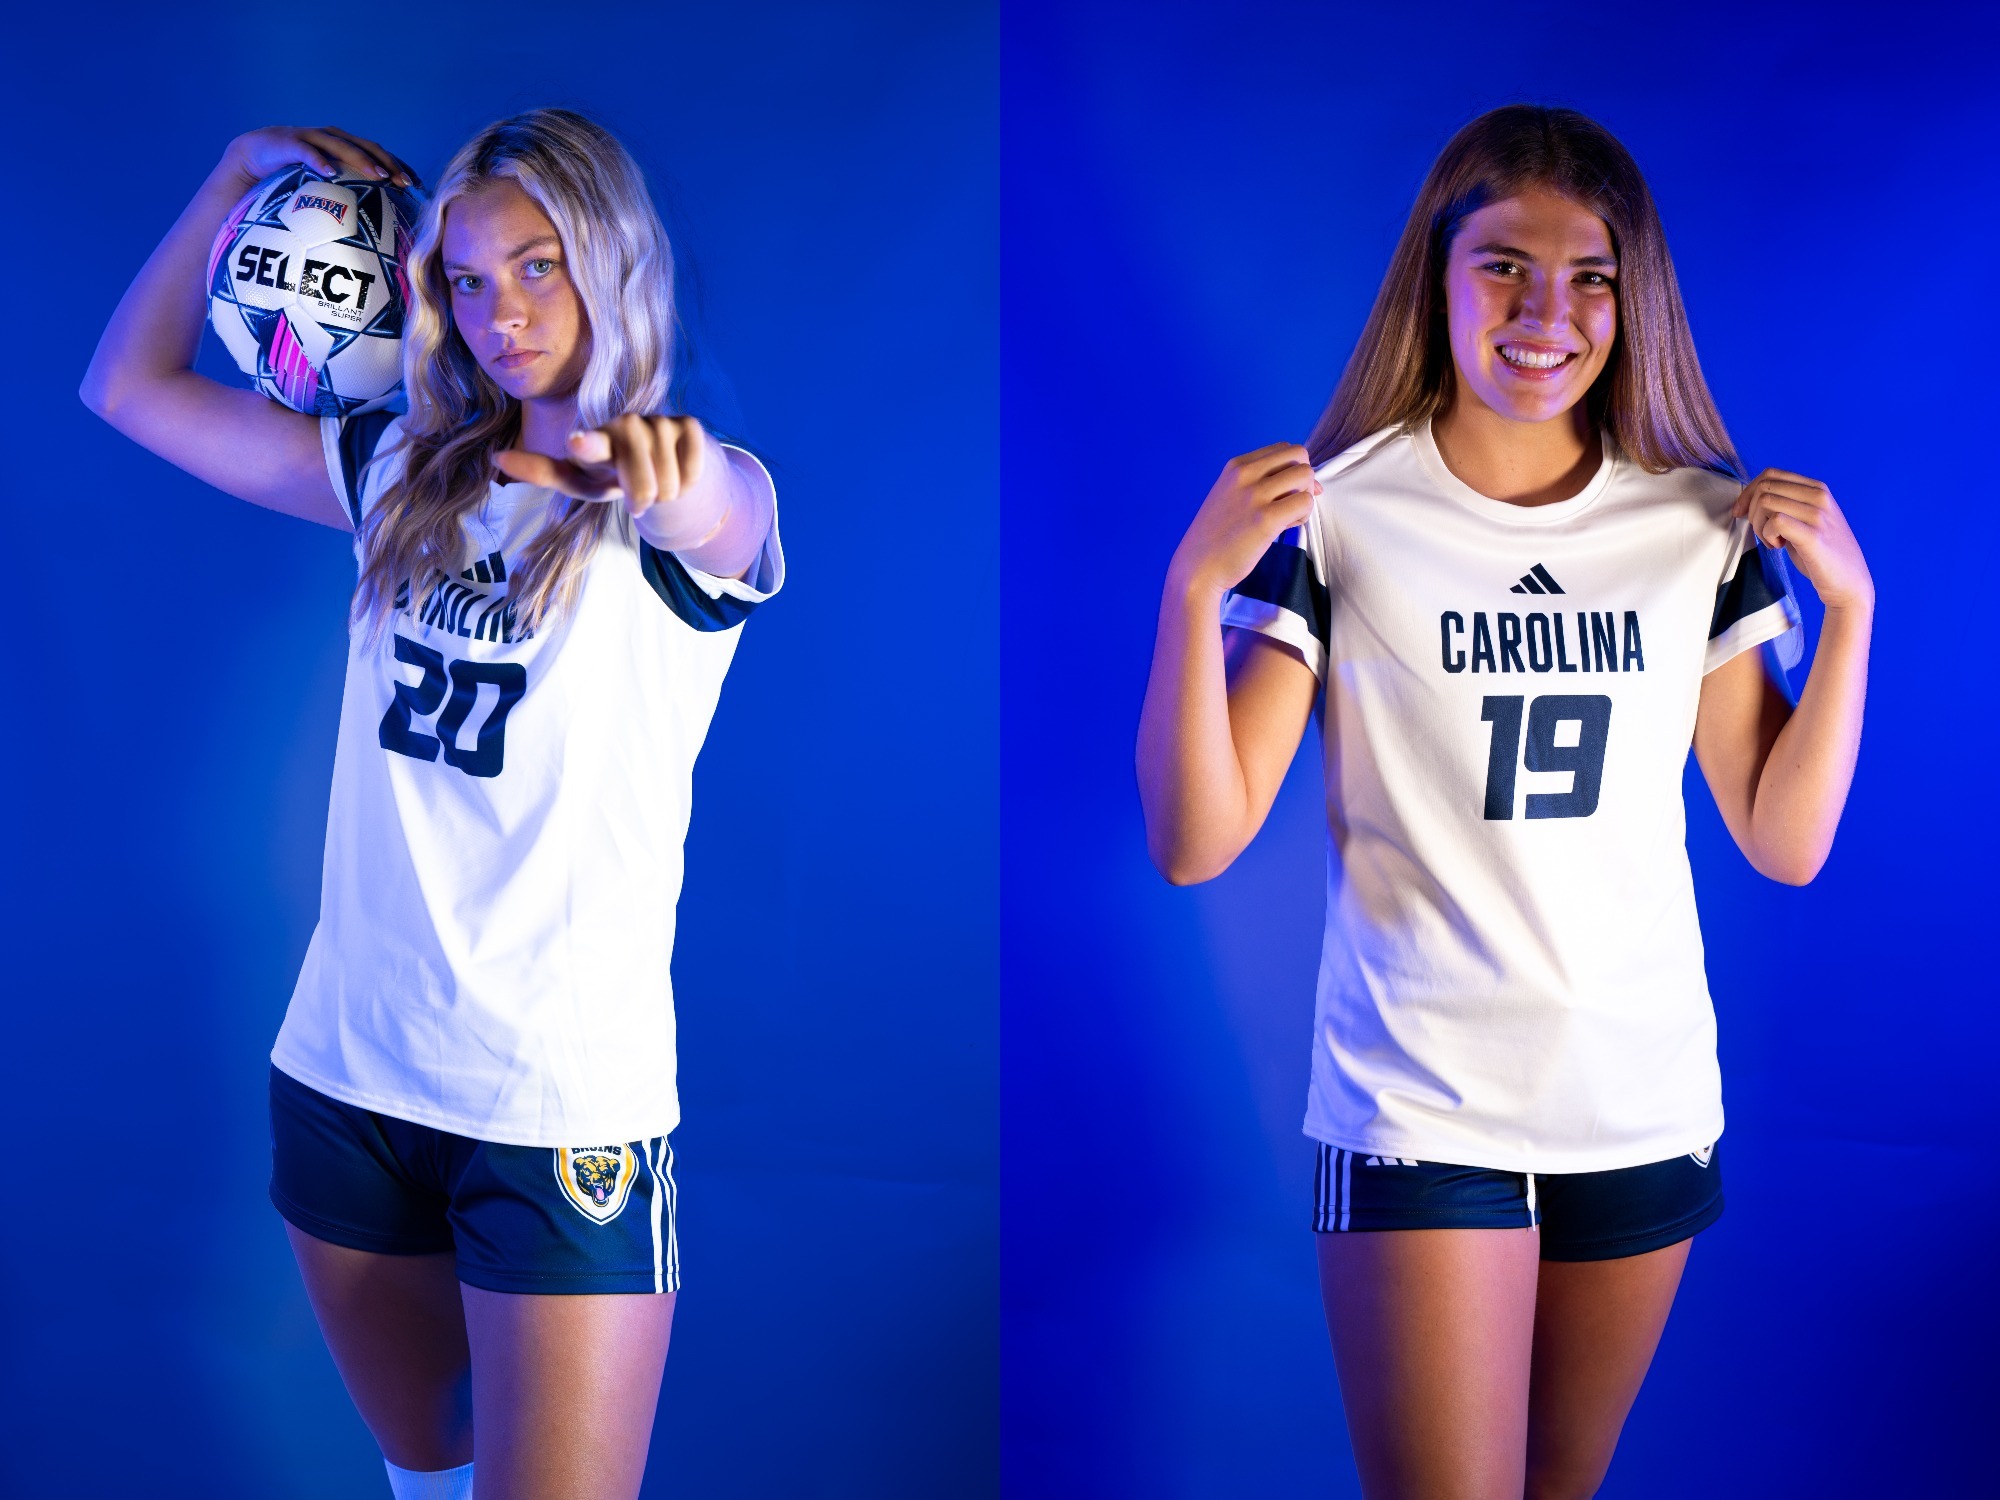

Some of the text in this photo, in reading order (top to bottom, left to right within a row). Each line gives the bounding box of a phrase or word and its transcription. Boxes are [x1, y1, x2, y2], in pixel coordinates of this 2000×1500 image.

[293, 194, 348, 224] NAIA
[236, 244, 375, 312] SELECT
[317, 300, 364, 317] BRILLANT
[330, 310, 363, 323] SUPER
[1440, 610, 1645, 674] CAROLINA
[379, 633, 527, 778] 20
[1480, 694, 1613, 821] 19
